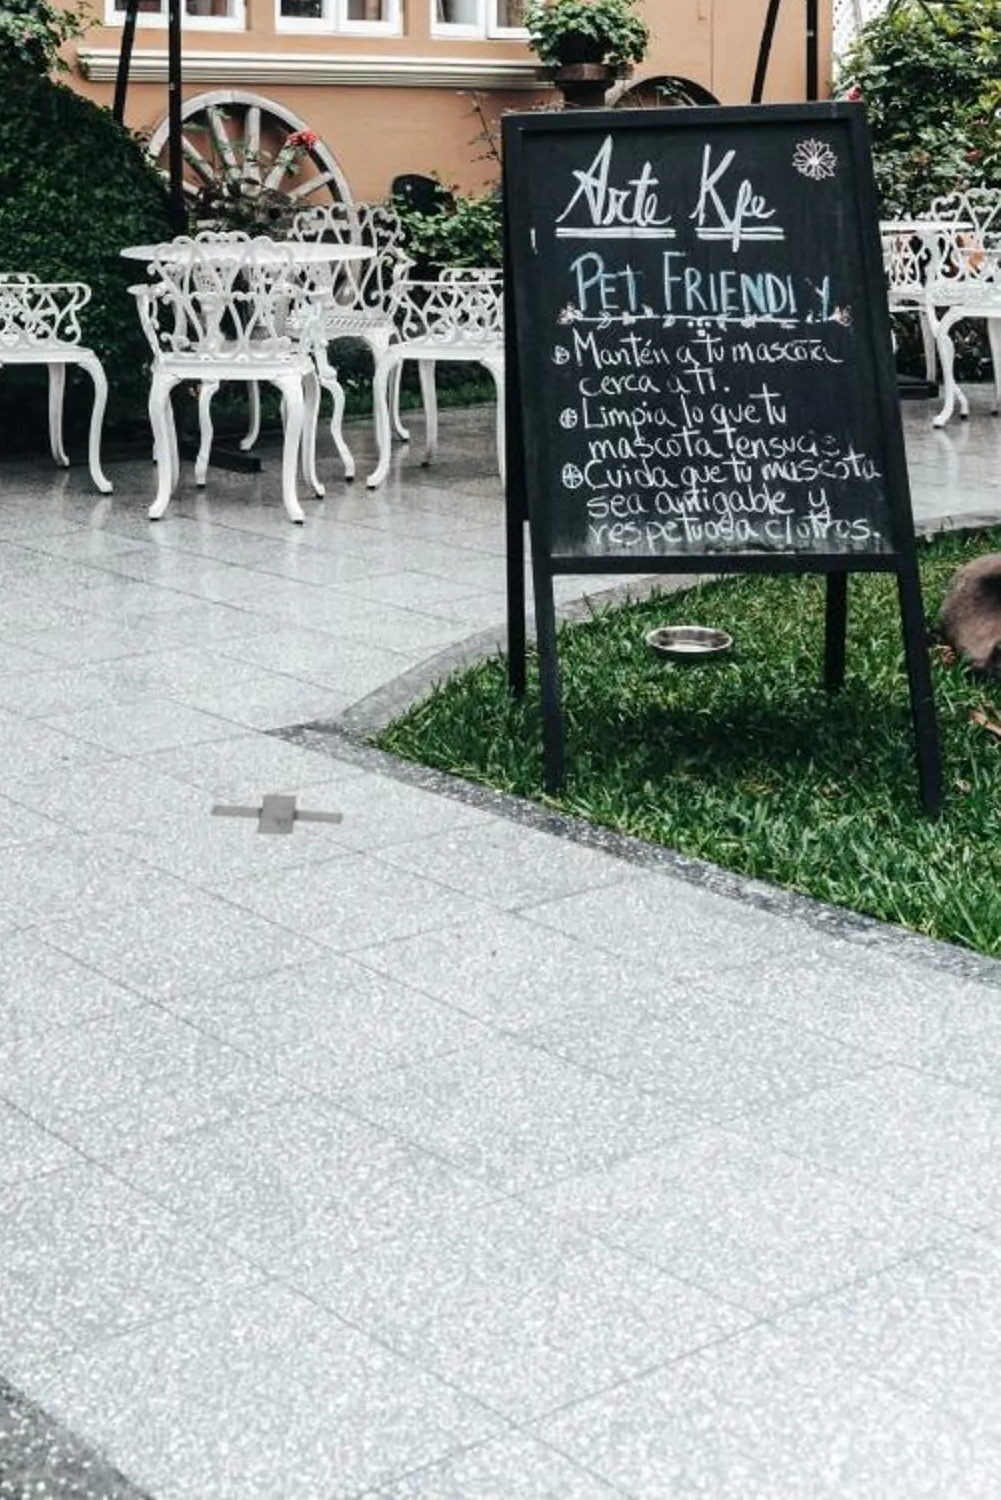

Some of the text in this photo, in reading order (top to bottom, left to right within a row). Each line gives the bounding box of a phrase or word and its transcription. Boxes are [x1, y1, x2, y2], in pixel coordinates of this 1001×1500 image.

[555, 134, 672, 227] Arte
[571, 326, 845, 370] Mantén a tu mascota
[578, 373, 661, 397] cerca
[666, 376, 692, 394] a
[581, 382, 788, 442] Limpia lo que tu
[588, 425, 725, 460] mascota
[583, 442, 882, 500] Cuida que tu mascota
[586, 492, 650, 519] sea
[807, 486, 833, 520] y
